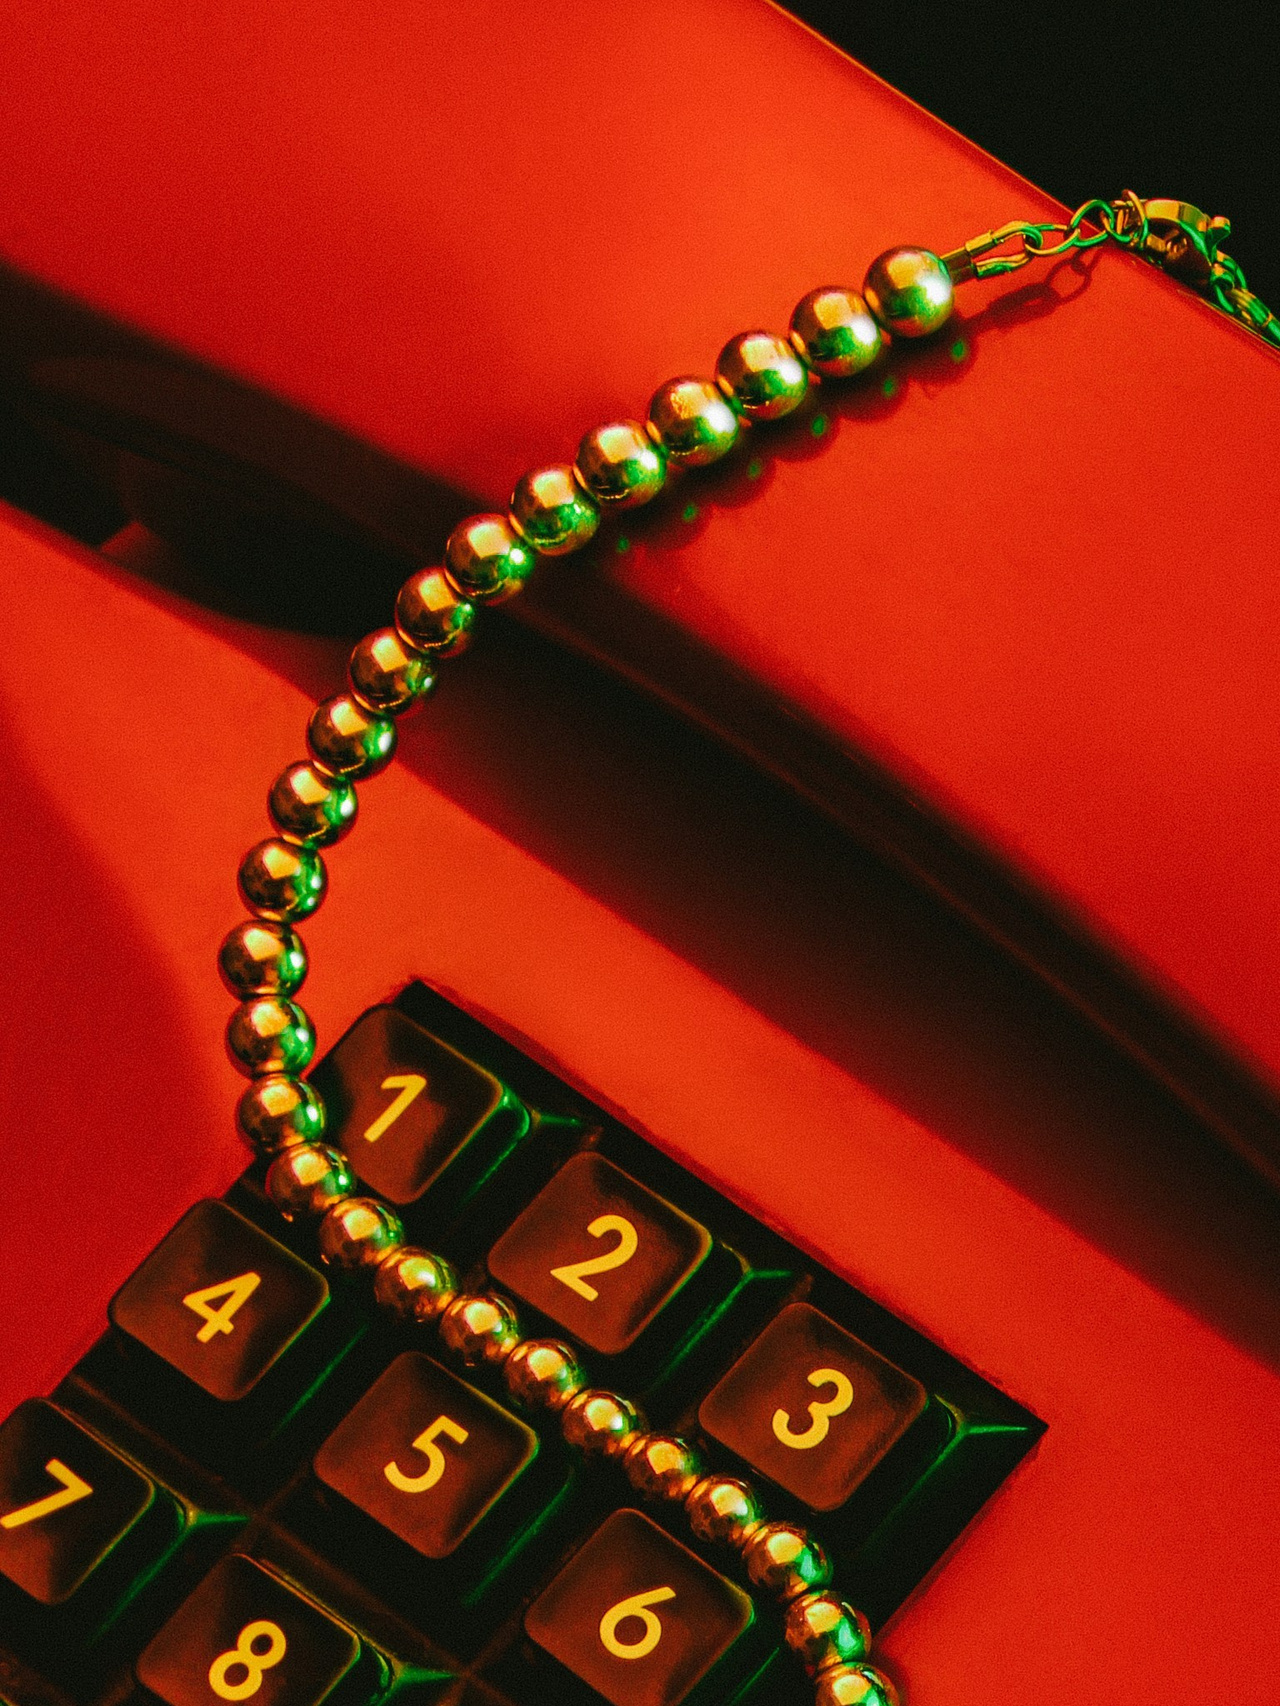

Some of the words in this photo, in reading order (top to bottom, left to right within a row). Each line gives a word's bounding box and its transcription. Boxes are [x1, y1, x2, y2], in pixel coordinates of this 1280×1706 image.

[363, 1074, 426, 1143] 1
[550, 1214, 638, 1302] 2
[183, 1272, 261, 1344] 4
[772, 1368, 854, 1450] 3
[383, 1415, 469, 1494] 5
[0, 1459, 93, 1530] 7
[208, 1620, 287, 1701] 8
[599, 1586, 676, 1660] 6
